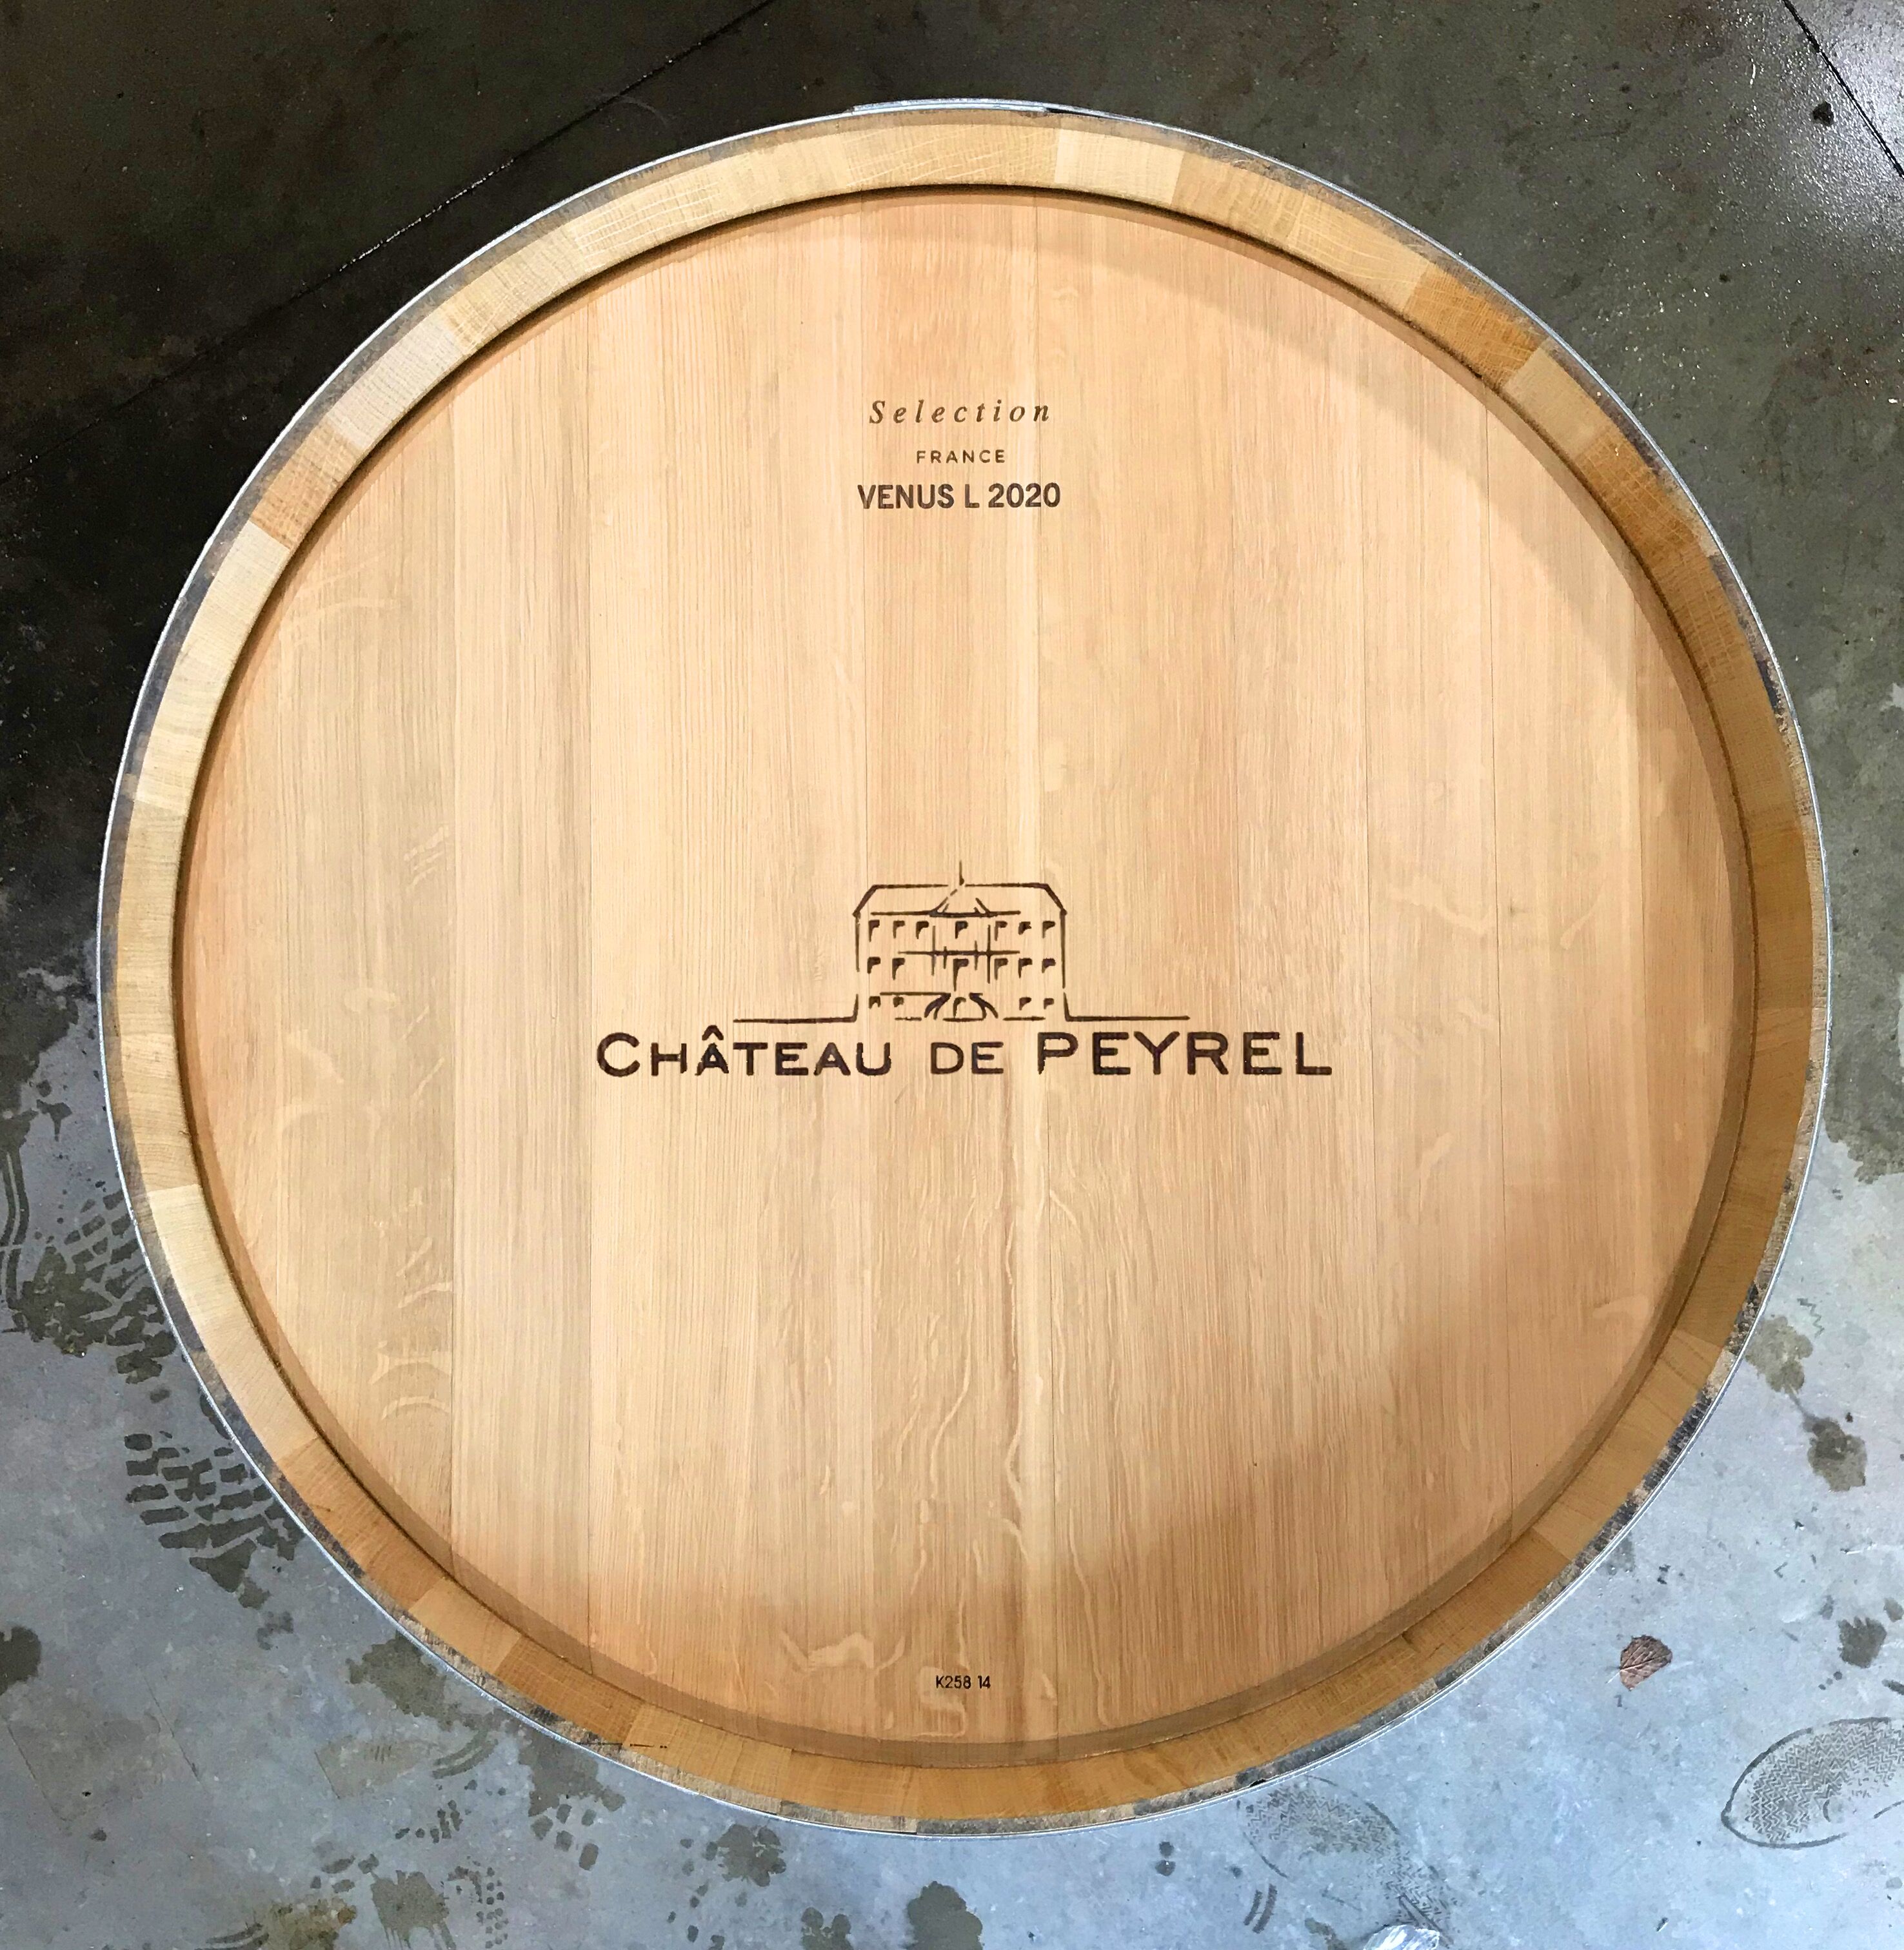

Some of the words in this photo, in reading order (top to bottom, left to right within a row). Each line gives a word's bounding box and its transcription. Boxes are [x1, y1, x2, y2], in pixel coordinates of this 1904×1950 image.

[869, 400, 1049, 424] Selection
[917, 449, 1004, 464] FRANCE
[858, 484, 954, 509] VENUS
[965, 484, 980, 508] L
[989, 482, 1060, 507] 2020
[597, 1025, 891, 1077] CHÂTEAU
[931, 1041, 1004, 1074] DE
[1038, 1031, 1332, 1076] PEYREL
[936, 1675, 971, 1689] K258
[977, 1675, 991, 1689] 14
